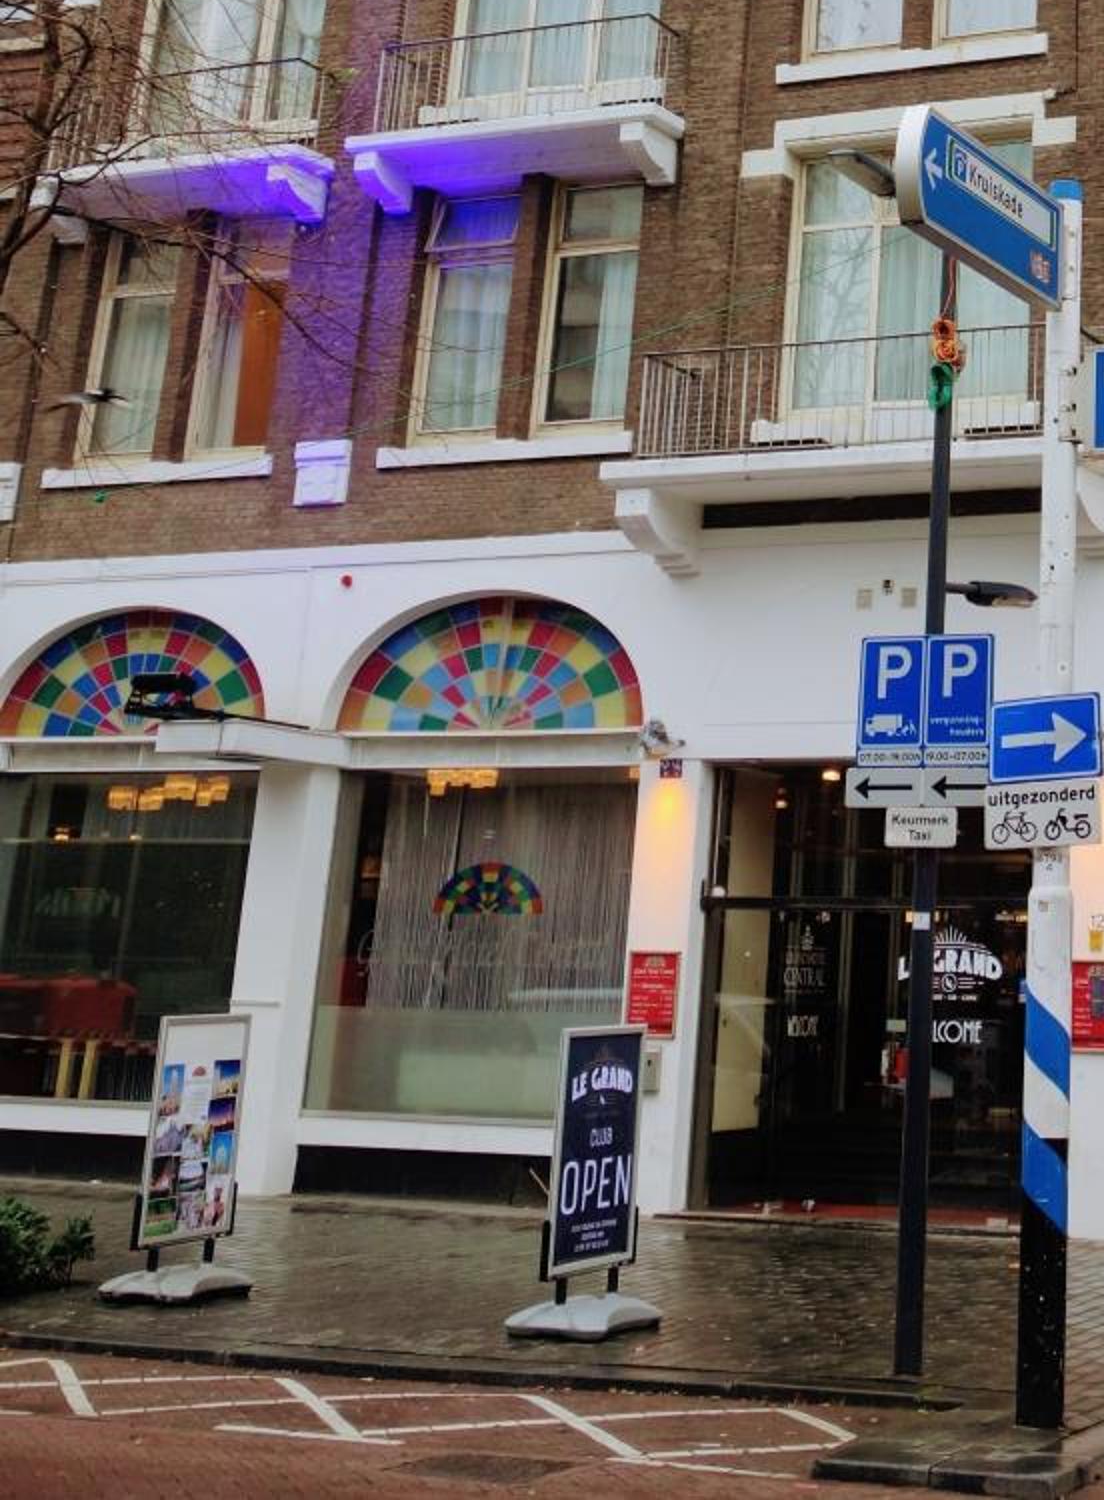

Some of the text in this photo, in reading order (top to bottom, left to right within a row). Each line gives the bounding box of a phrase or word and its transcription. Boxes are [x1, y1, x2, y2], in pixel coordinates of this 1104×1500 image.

[969, 164, 1023, 218] Kruiskade
[877, 645, 912, 699] P
[942, 643, 977, 698] P
[989, 784, 1095, 809] uitgezonderd
[892, 813, 949, 825] Keurmerk
[909, 829, 932, 841] Taxi
[932, 1019, 983, 1045] LCOME
[571, 1066, 633, 1103] LE GRAND
[589, 1126, 614, 1149] CLUB
[560, 1154, 632, 1216] OPEN
